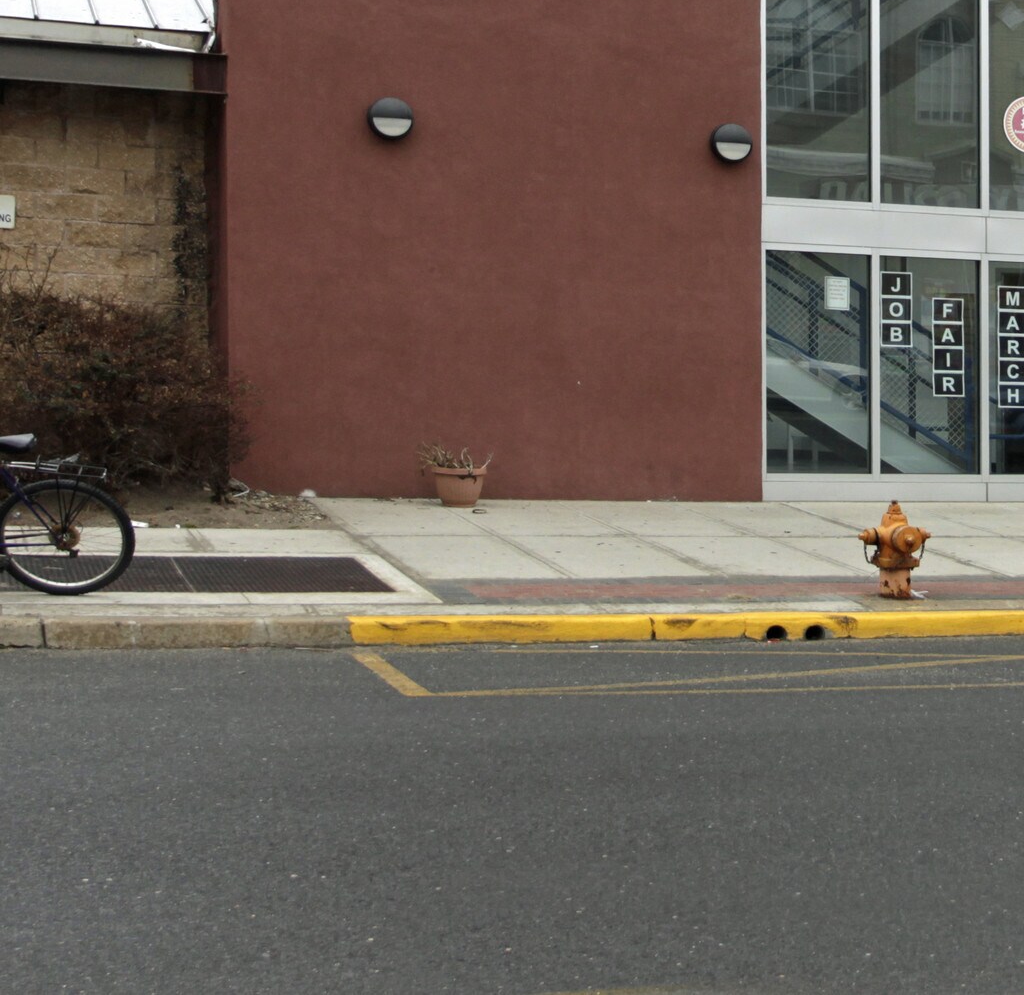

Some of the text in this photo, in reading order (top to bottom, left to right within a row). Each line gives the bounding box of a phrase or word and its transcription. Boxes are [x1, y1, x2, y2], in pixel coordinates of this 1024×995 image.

[889, 277, 904, 342] JOB
[942, 303, 956, 392] FAIR
[1005, 291, 1020, 404] MARCH
